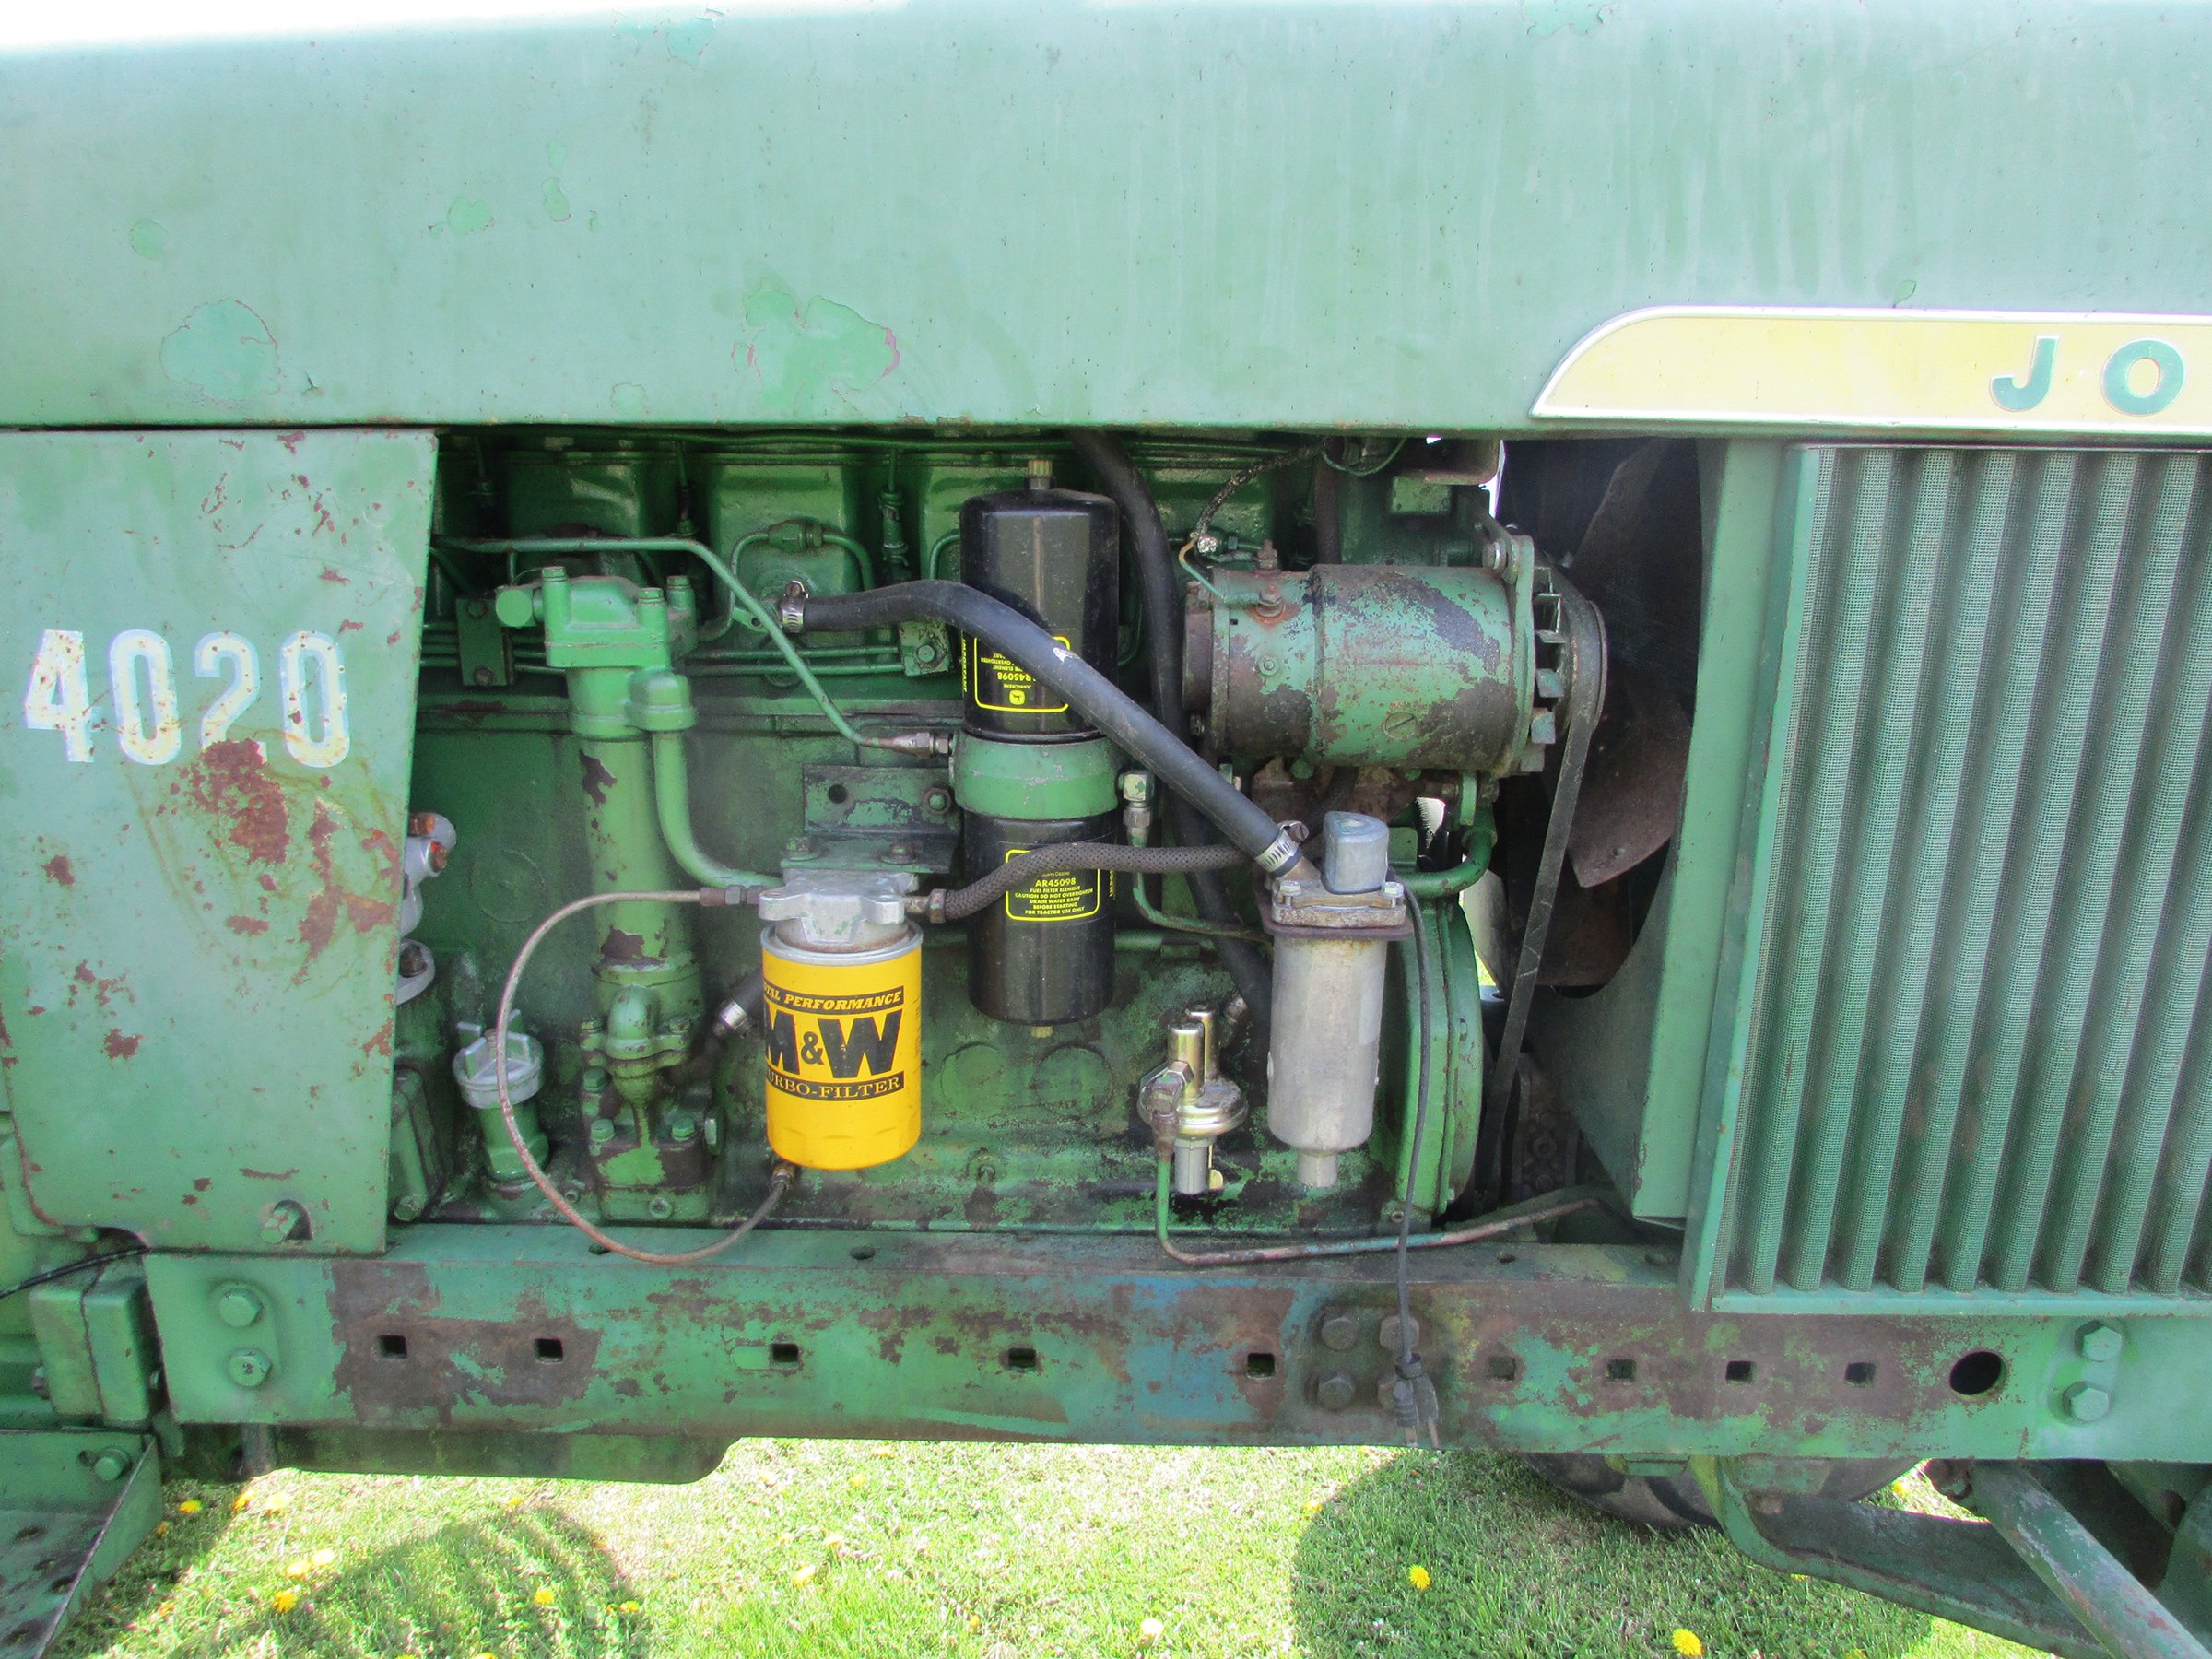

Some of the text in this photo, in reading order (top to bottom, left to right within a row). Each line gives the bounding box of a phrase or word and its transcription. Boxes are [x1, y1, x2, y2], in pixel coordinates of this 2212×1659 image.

[1989, 335, 2187, 417] JO
[997, 672, 1037, 682] R45098
[23, 629, 351, 768] 4020
[1035, 877, 1077, 888] AR45098
[1062, 888, 1094, 898] OVERTIGHTEN
[764, 982, 903, 1011] TAL PERFORMANCE
[767, 1067, 900, 1099] URBO-FILTER
